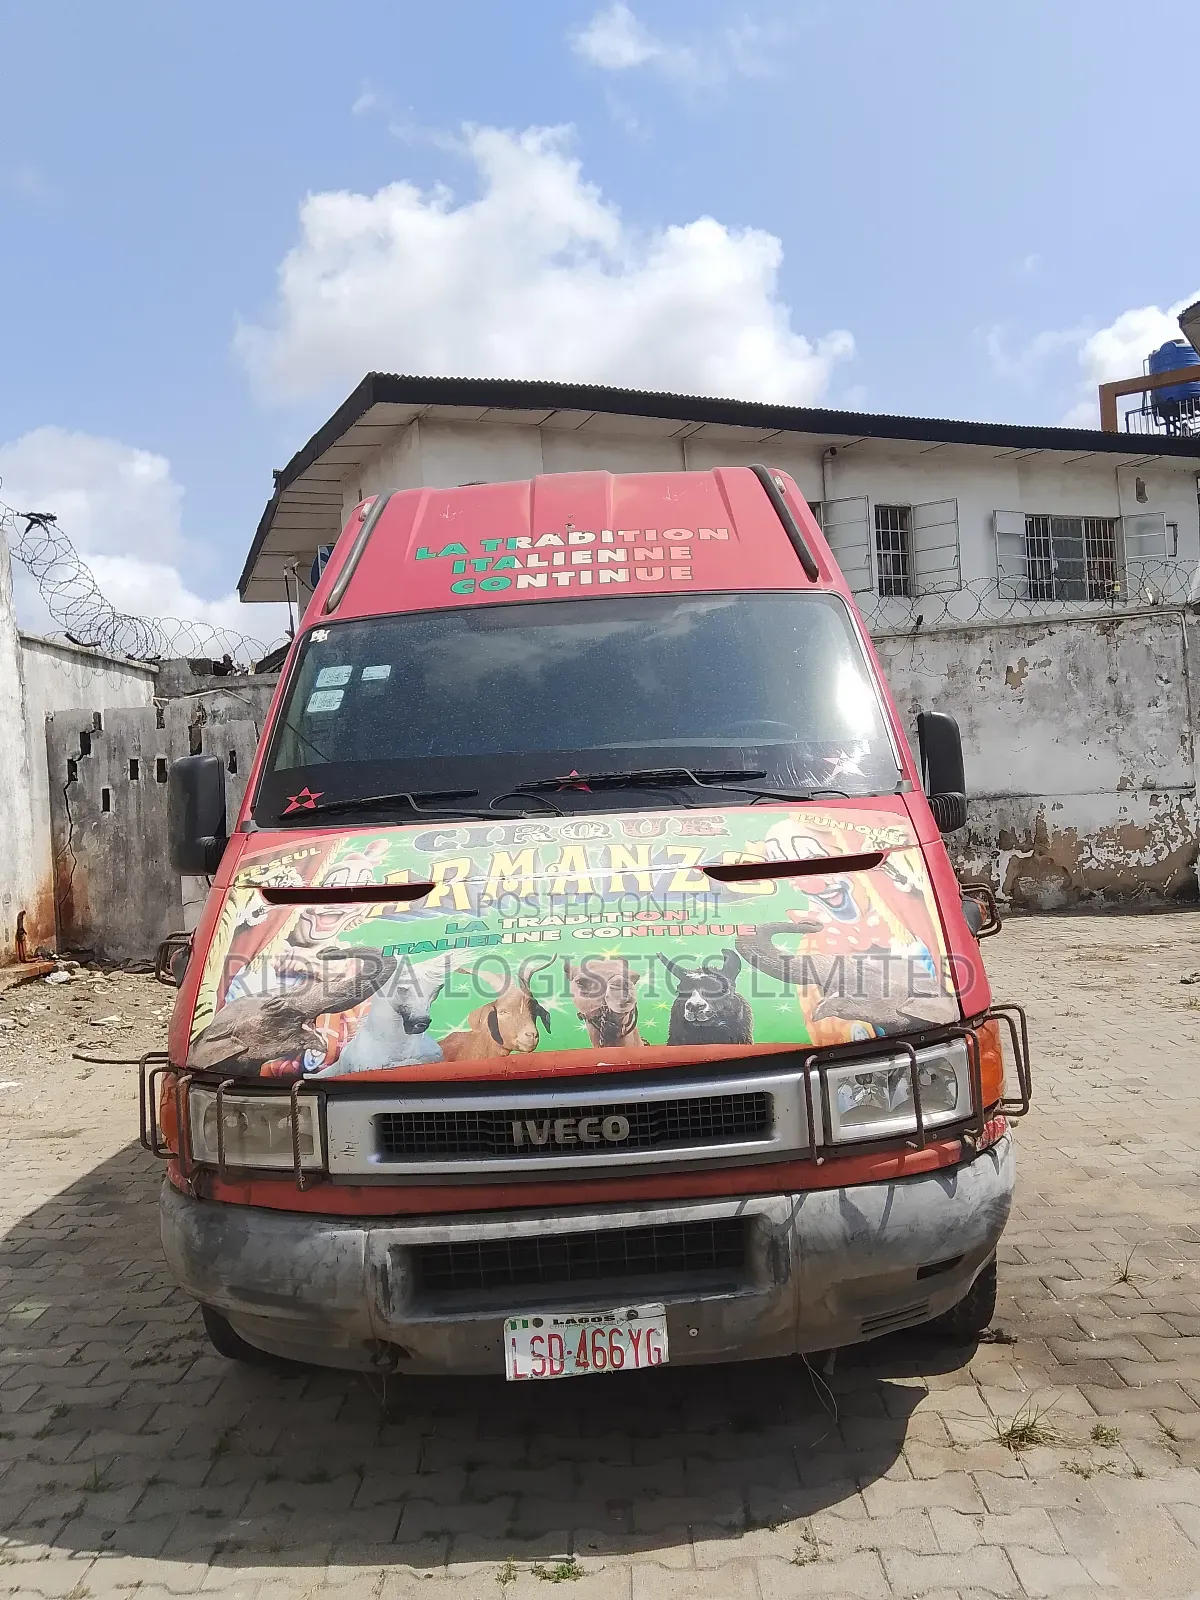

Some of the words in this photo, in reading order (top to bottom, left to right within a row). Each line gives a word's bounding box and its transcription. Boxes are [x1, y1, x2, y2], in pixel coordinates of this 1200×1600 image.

[415, 541, 468, 560] LA
[481, 527, 729, 552] TRADITION
[452, 546, 693, 574] ITALIENNE
[450, 566, 693, 594] CONTINUE
[413, 815, 731, 853] CIRQUE
[238, 865, 262, 882] LE
[268, 847, 322, 869] SEUL
[445, 921, 490, 935] LA
[498, 909, 690, 929] TRADITION
[381, 929, 561, 958] ITALIENNE
[572, 923, 757, 940] CONTINUE
[512, 1115, 630, 1146] IVECO
[552, 1314, 616, 1326] LAGOS
